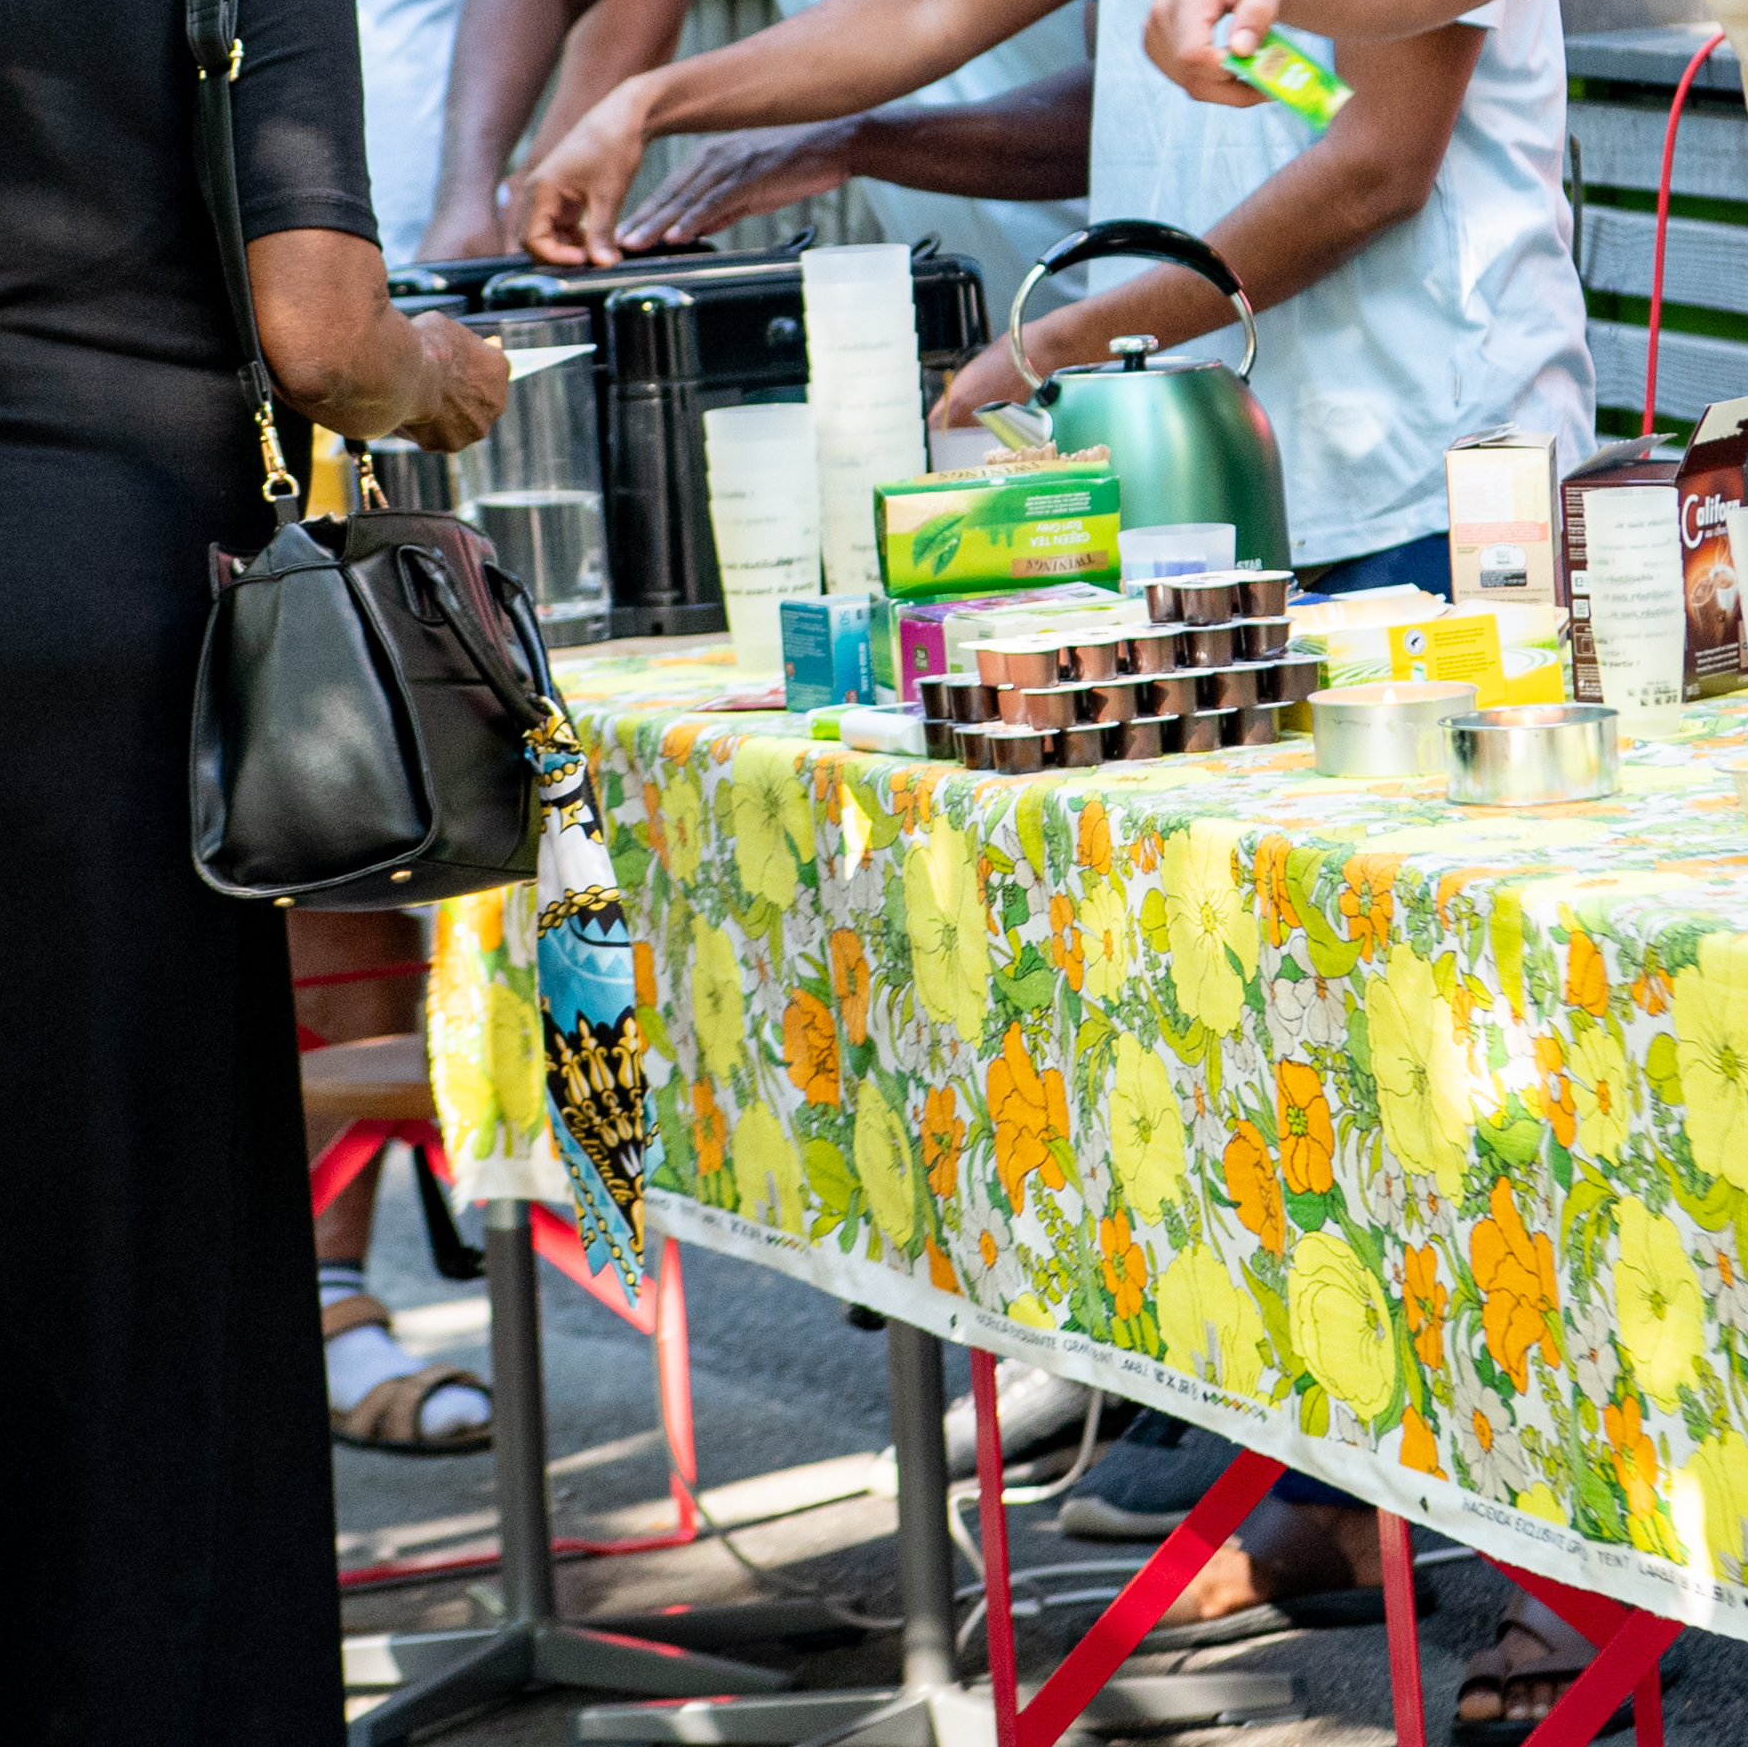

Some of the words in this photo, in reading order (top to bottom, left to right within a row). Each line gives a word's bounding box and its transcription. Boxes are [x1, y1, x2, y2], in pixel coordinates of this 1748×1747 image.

[1063, 520, 1084, 532] Earl
[1029, 535, 1051, 548] TEA
[1052, 531, 1091, 545] GREEN
[1025, 552, 1096, 573] TWININGS
